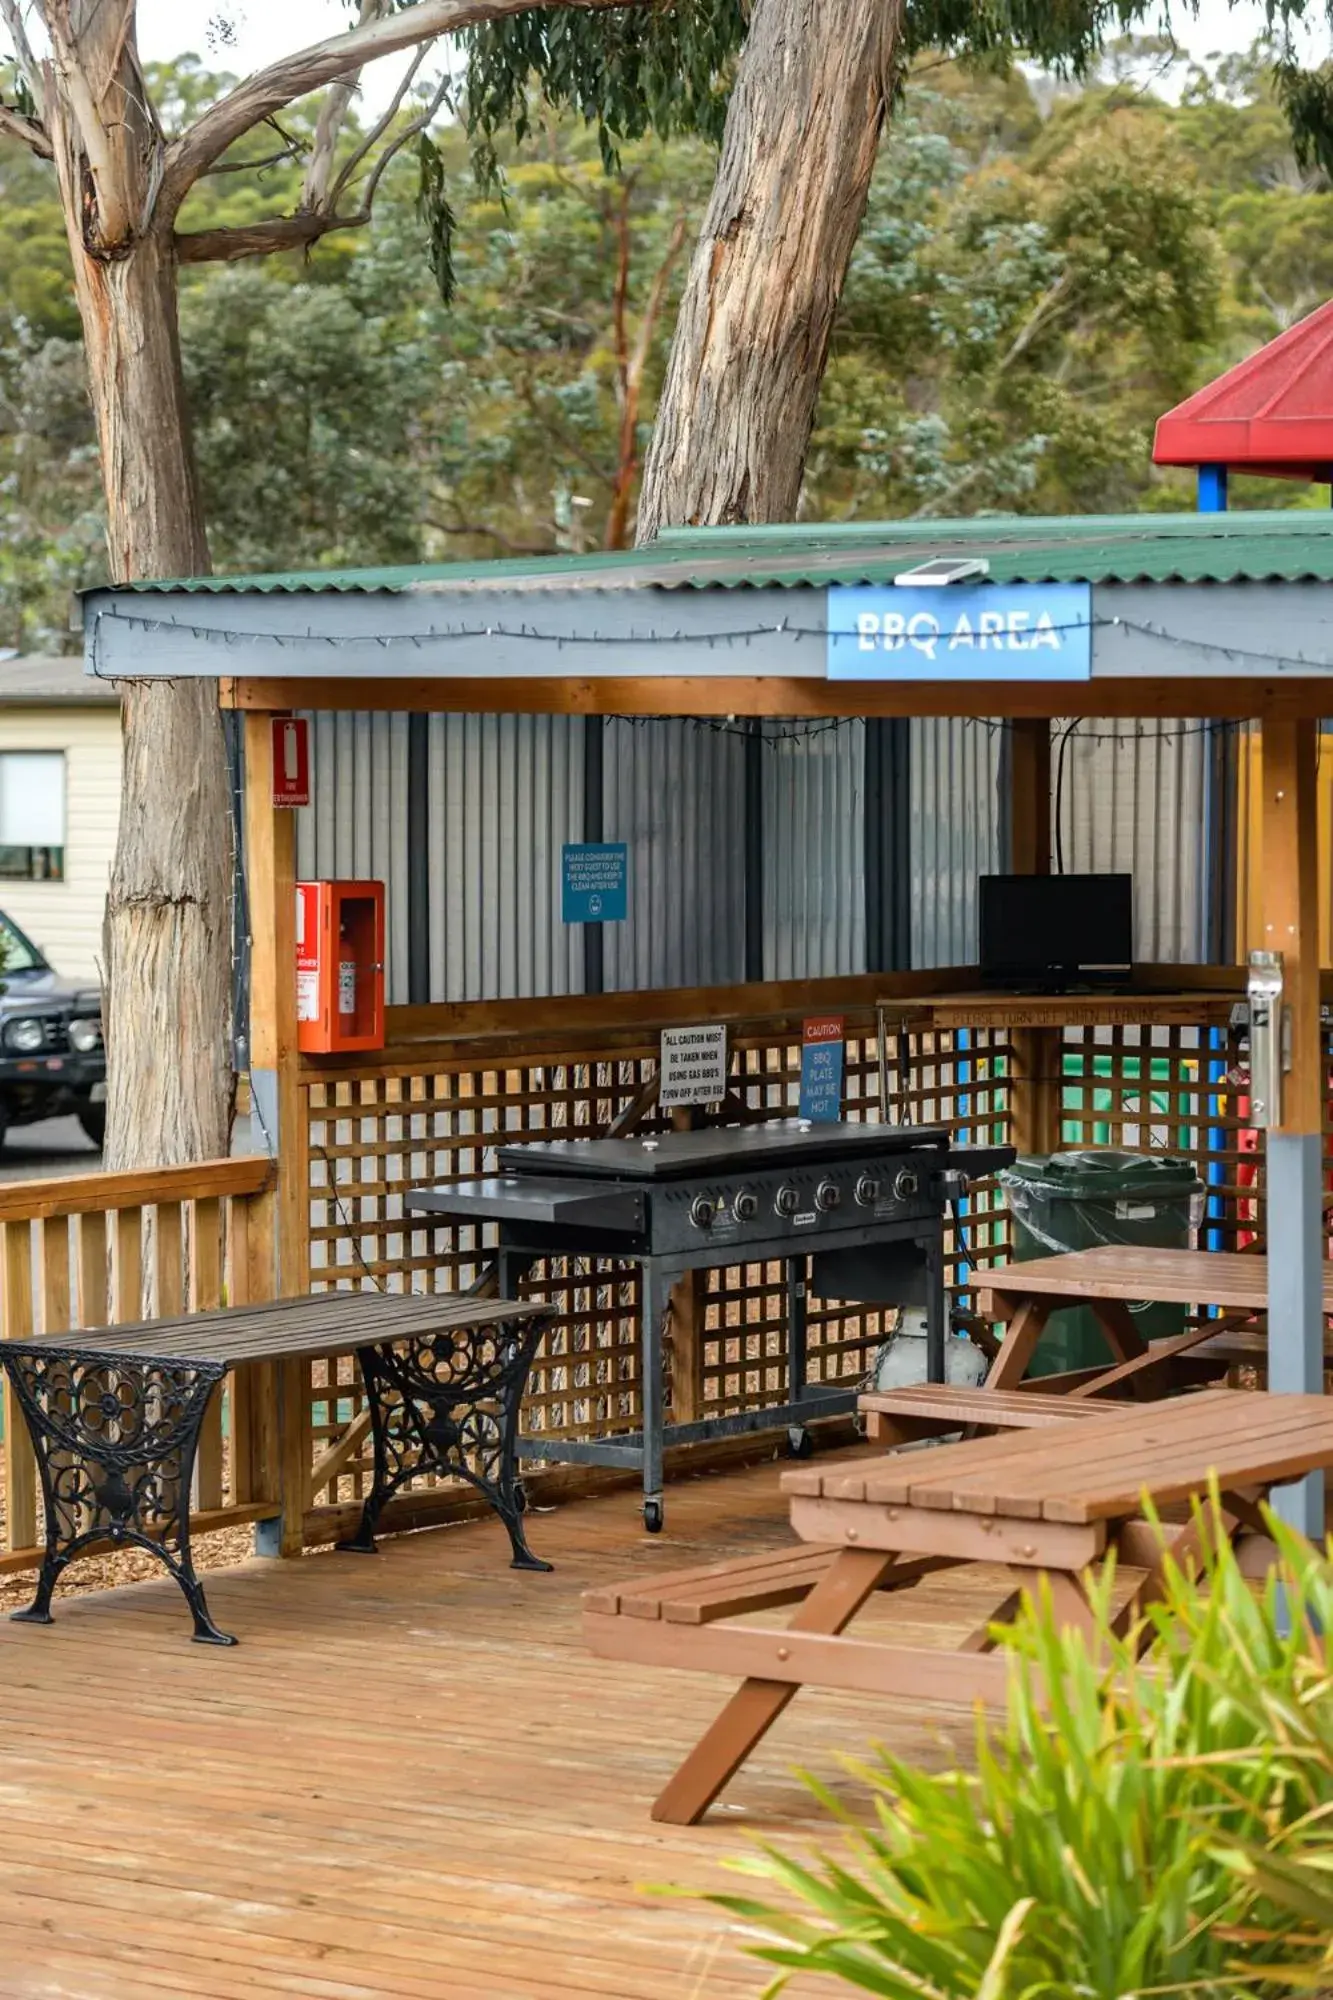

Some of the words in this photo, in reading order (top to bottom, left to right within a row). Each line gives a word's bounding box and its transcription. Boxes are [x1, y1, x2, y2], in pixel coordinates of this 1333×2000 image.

[857, 612, 940, 660] BBQ
[948, 610, 1061, 651] AREA
[1002, 1010, 1033, 1025] TURN
[1037, 1009, 1057, 1024] OFF
[807, 1023, 841, 1038] CAUTION
[666, 1036, 677, 1046] ALL
[678, 1034, 704, 1045] CAUTION
[706, 1032, 722, 1043] MUST
[670, 1053, 678, 1063] BE
[681, 1052, 699, 1063] TAKEN
[701, 1050, 718, 1061] WHEN
[813, 1051, 832, 1066] BBQ
[669, 1070, 687, 1081] USING
[689, 1069, 700, 1079] GAS
[810, 1067, 833, 1082] PLATE
[662, 1088, 679, 1099] TURN
[680, 1087, 691, 1098] OFF
[692, 1086, 711, 1096] AFTER
[806, 1085, 823, 1098] MAY
[825, 1083, 836, 1096] BE
[811, 1100, 829, 1113] HOT
